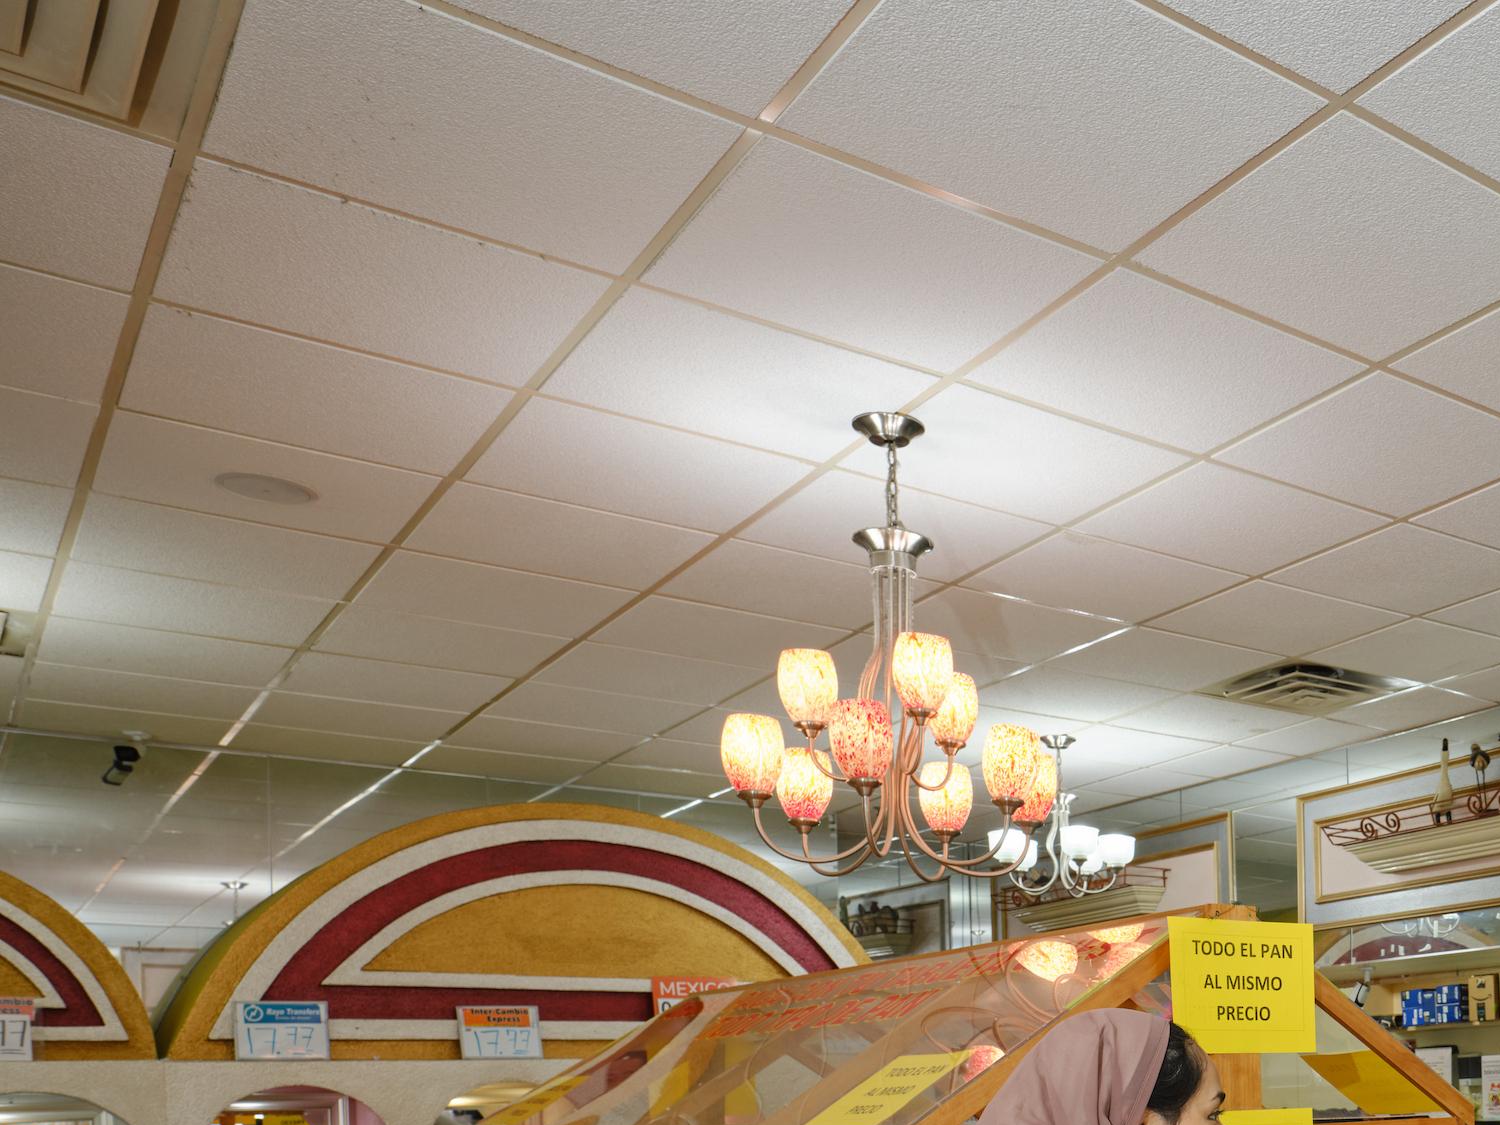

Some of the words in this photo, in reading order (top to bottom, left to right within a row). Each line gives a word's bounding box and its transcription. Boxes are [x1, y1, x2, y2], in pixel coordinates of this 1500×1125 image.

[1192, 940, 1235, 957] TODO
[1240, 943, 1256, 957] EL
[1261, 944, 1293, 959] PAN
[1204, 974, 1222, 989] AL
[1226, 975, 1282, 991] MISMO
[1217, 1005, 1271, 1021] PRECIO
